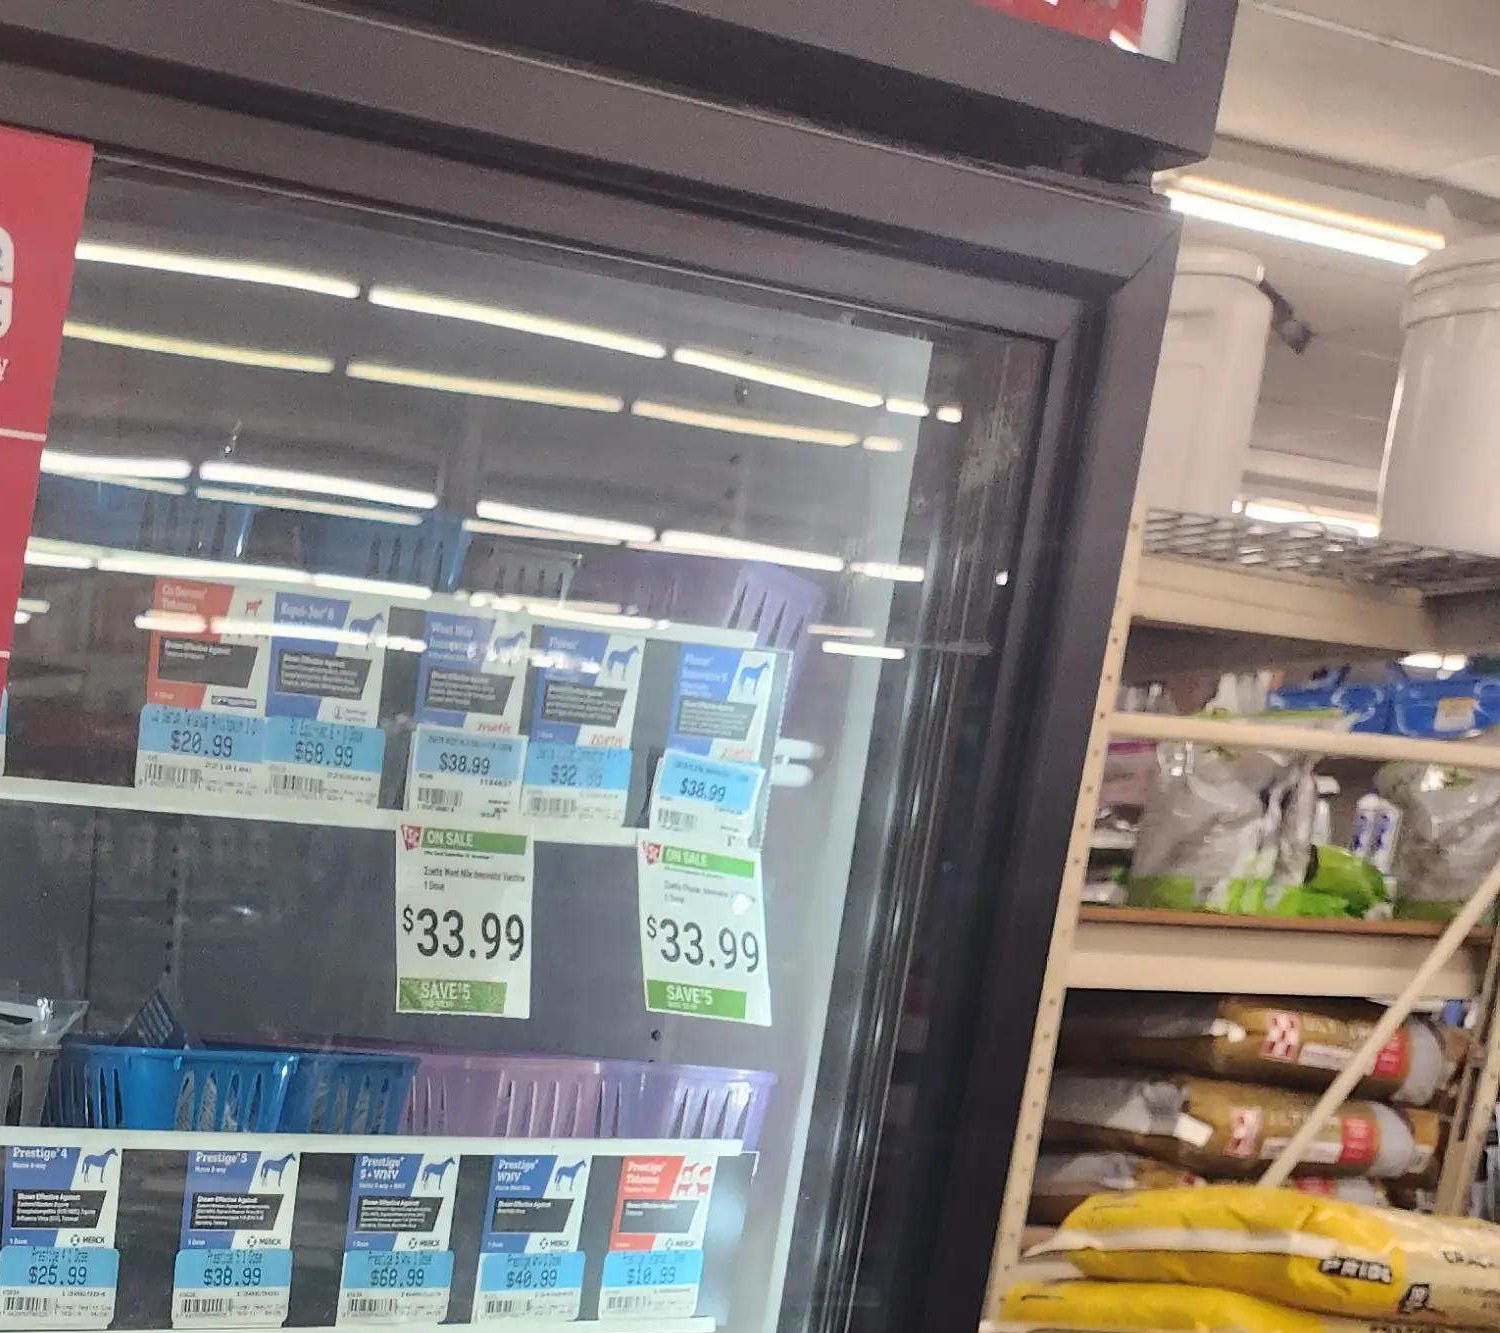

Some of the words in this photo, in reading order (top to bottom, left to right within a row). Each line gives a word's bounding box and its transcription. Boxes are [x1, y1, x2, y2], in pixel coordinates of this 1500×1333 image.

[170, 730, 233, 758] $20.99
[439, 753, 490, 775] $38.99
[679, 778, 726, 803] $38.99
[447, 832, 474, 848] SALE
[402, 906, 525, 962] $33.99
[646, 916, 759, 973] $33.99
[28, 1266, 87, 1286] $25.99
[204, 1267, 262, 1286] $38.99
